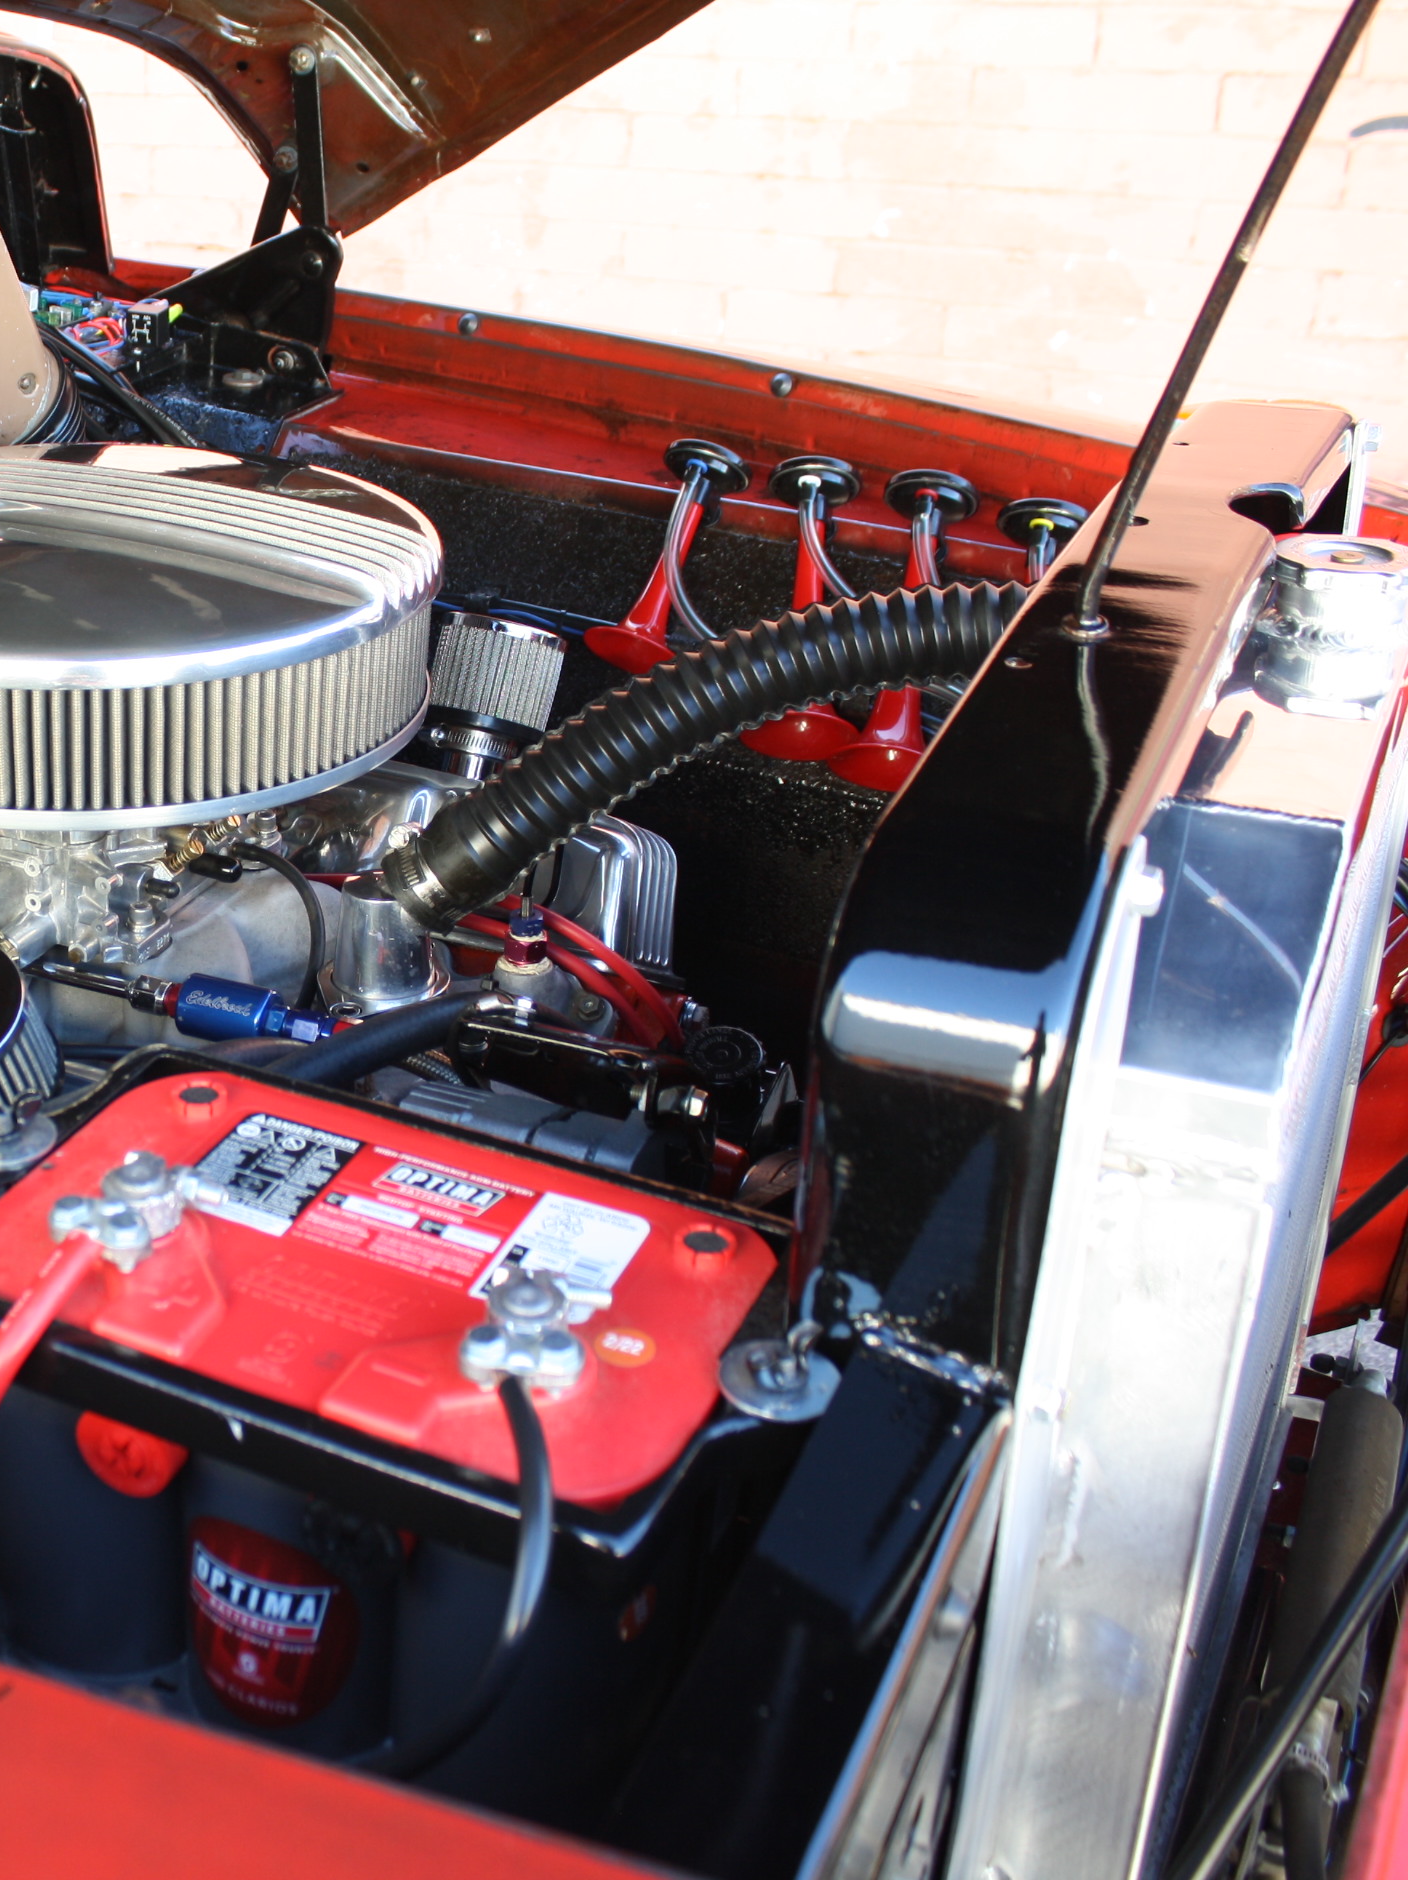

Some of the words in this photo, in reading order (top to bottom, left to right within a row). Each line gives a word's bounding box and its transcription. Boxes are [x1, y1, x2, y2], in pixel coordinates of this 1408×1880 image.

[185, 989, 253, 1017] Edelbrock
[266, 1117, 360, 1154] DANGER/POISON
[390, 1166, 495, 1207] OPTIMA
[398, 1186, 460, 1210] BATTERIES
[492, 1178, 535, 1198] BATTERY
[602, 1331, 644, 1355] 2/22
[196, 1555, 318, 1623] OPTIMA
[208, 1596, 287, 1638] BATTERIES
